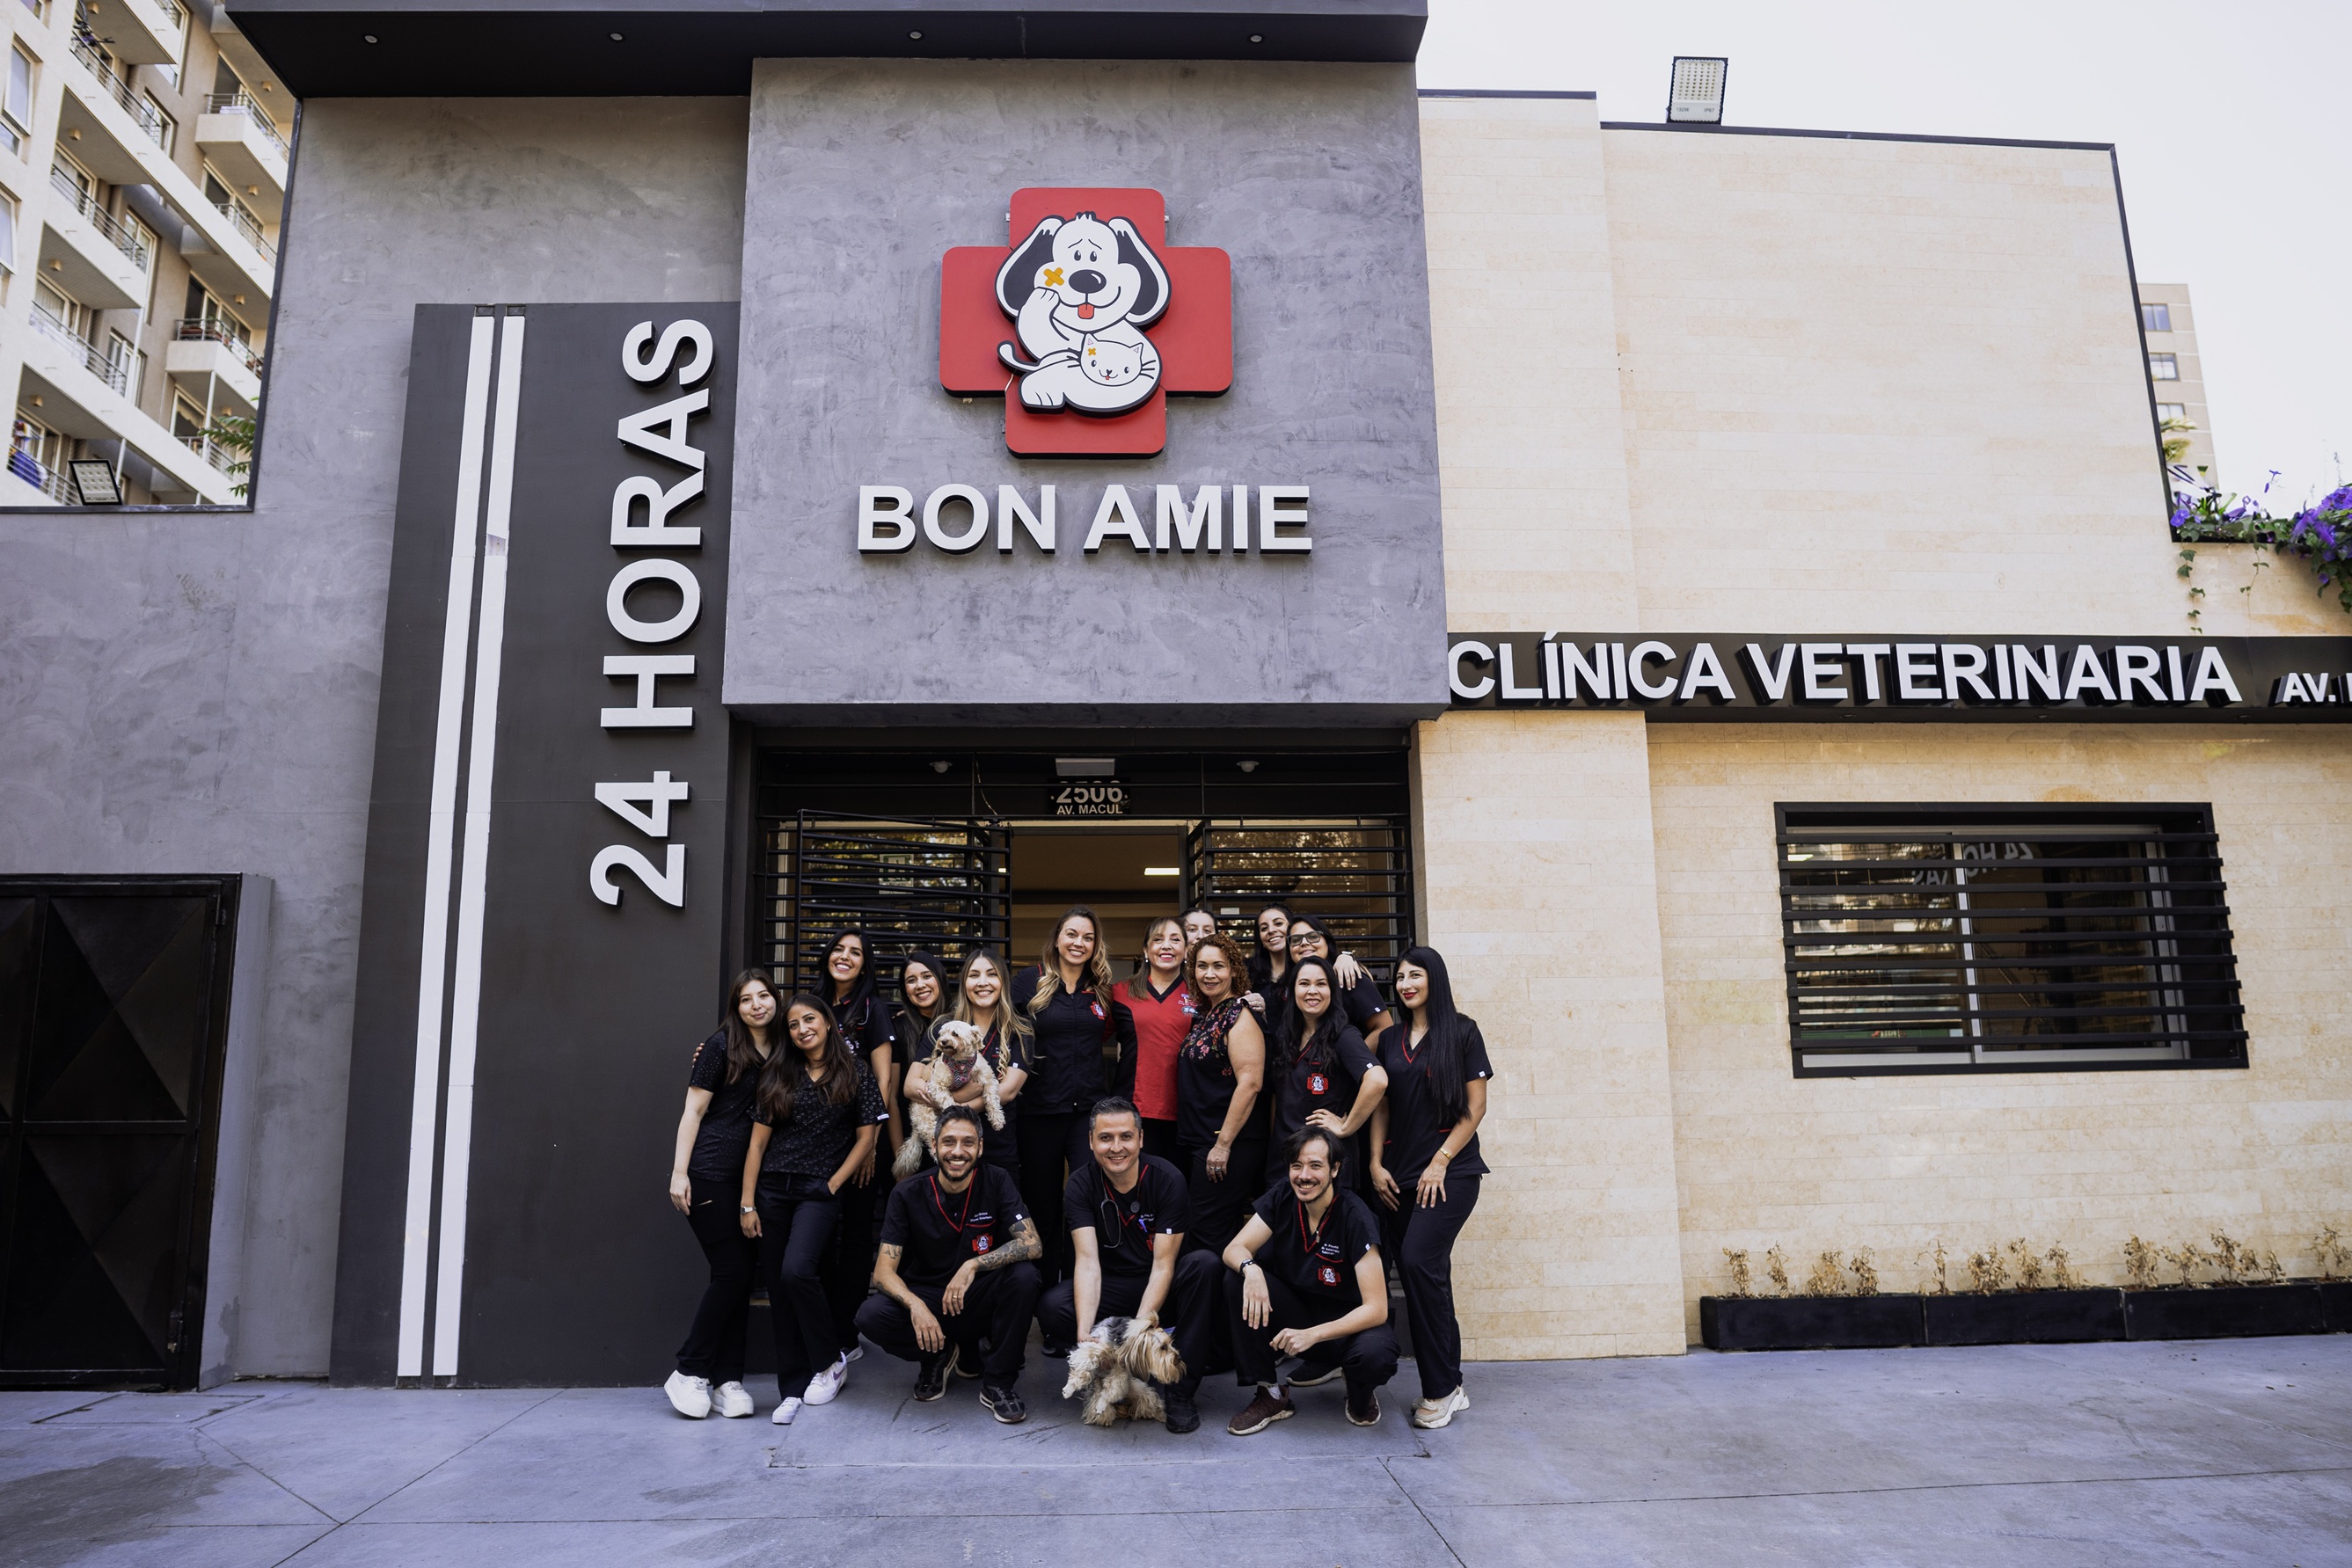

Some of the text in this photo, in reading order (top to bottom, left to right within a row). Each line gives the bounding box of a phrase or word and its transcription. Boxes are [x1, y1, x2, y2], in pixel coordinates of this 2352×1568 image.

[858, 483, 1312, 552] BON AMIE
[589, 318, 713, 908] 24 HORAS
[1448, 631, 1736, 700] CLÍNICA
[1746, 643, 2242, 701] VETERINARIA
[2283, 672, 2337, 702] AV.
[1056, 780, 1123, 804] 2506
[1056, 804, 1123, 815] AV. MACUL
